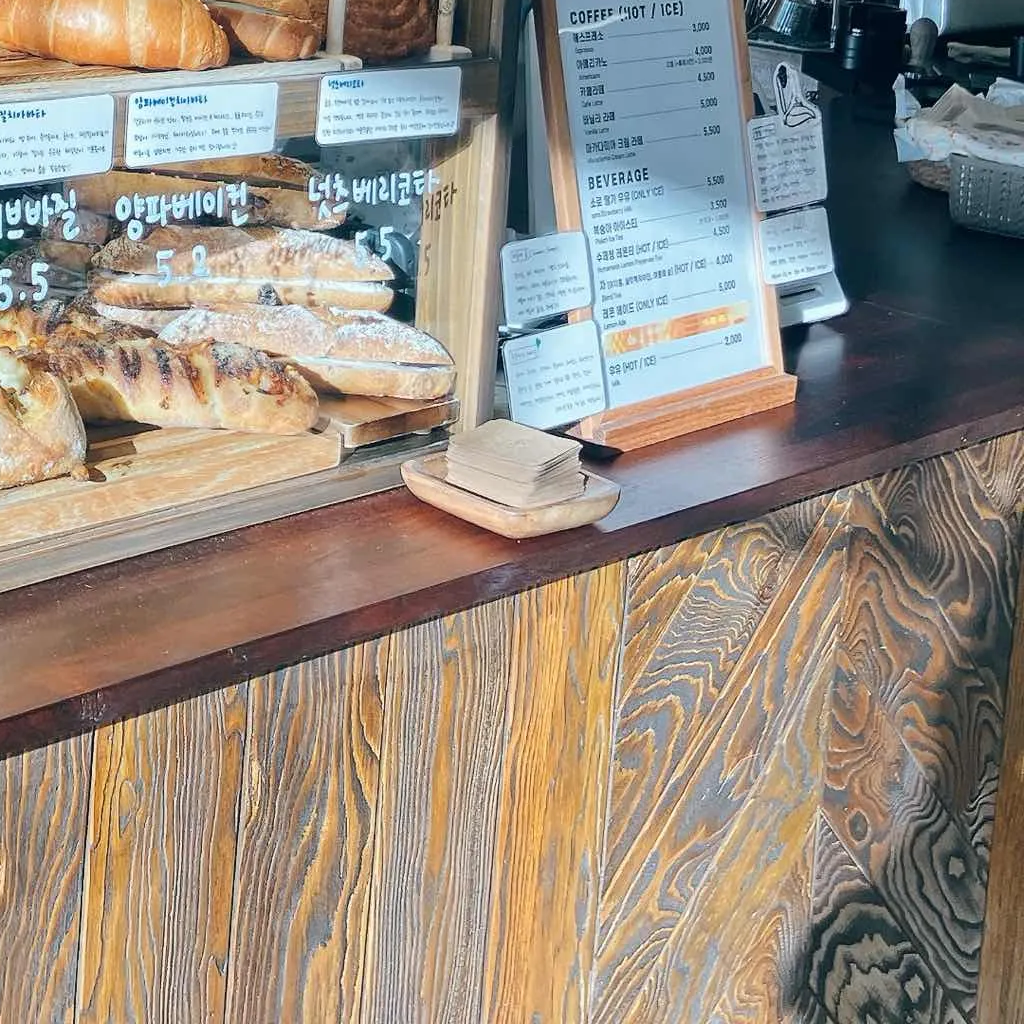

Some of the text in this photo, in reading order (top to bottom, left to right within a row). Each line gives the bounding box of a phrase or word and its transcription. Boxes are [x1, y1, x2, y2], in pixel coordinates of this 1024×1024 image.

[570, 8, 614, 25] COFFEE
[662, 0, 684, 17] ICE)
[692, 22, 710, 32] 3,000
[577, 46, 712, 70] 아메리카노 4,000
[579, 71, 715, 96] 카페라떼 4,500
[583, 97, 718, 125] 바닐라 라떼 5,000
[586, 125, 720, 153] 마카다미아 크림 라떼 5,500
[588, 167, 649, 190] BEVERAGE
[707, 175, 725, 186] 5,500
[115, 181, 249, 241] 양파베이컨
[593, 199, 727, 235] 복숭아 아이스티 3,500
[616, 245, 634, 258] 레몬티
[713, 225, 730, 237] 4,500
[716, 254, 733, 265] 4,000
[602, 280, 736, 319] 레몬 에이드 (ONLY ICE) 5,000
[609, 364, 622, 376] 우유
[622, 359, 637, 373] (HOT
[643, 355, 657, 368] ICE)
[724, 333, 742, 346] 2,000
